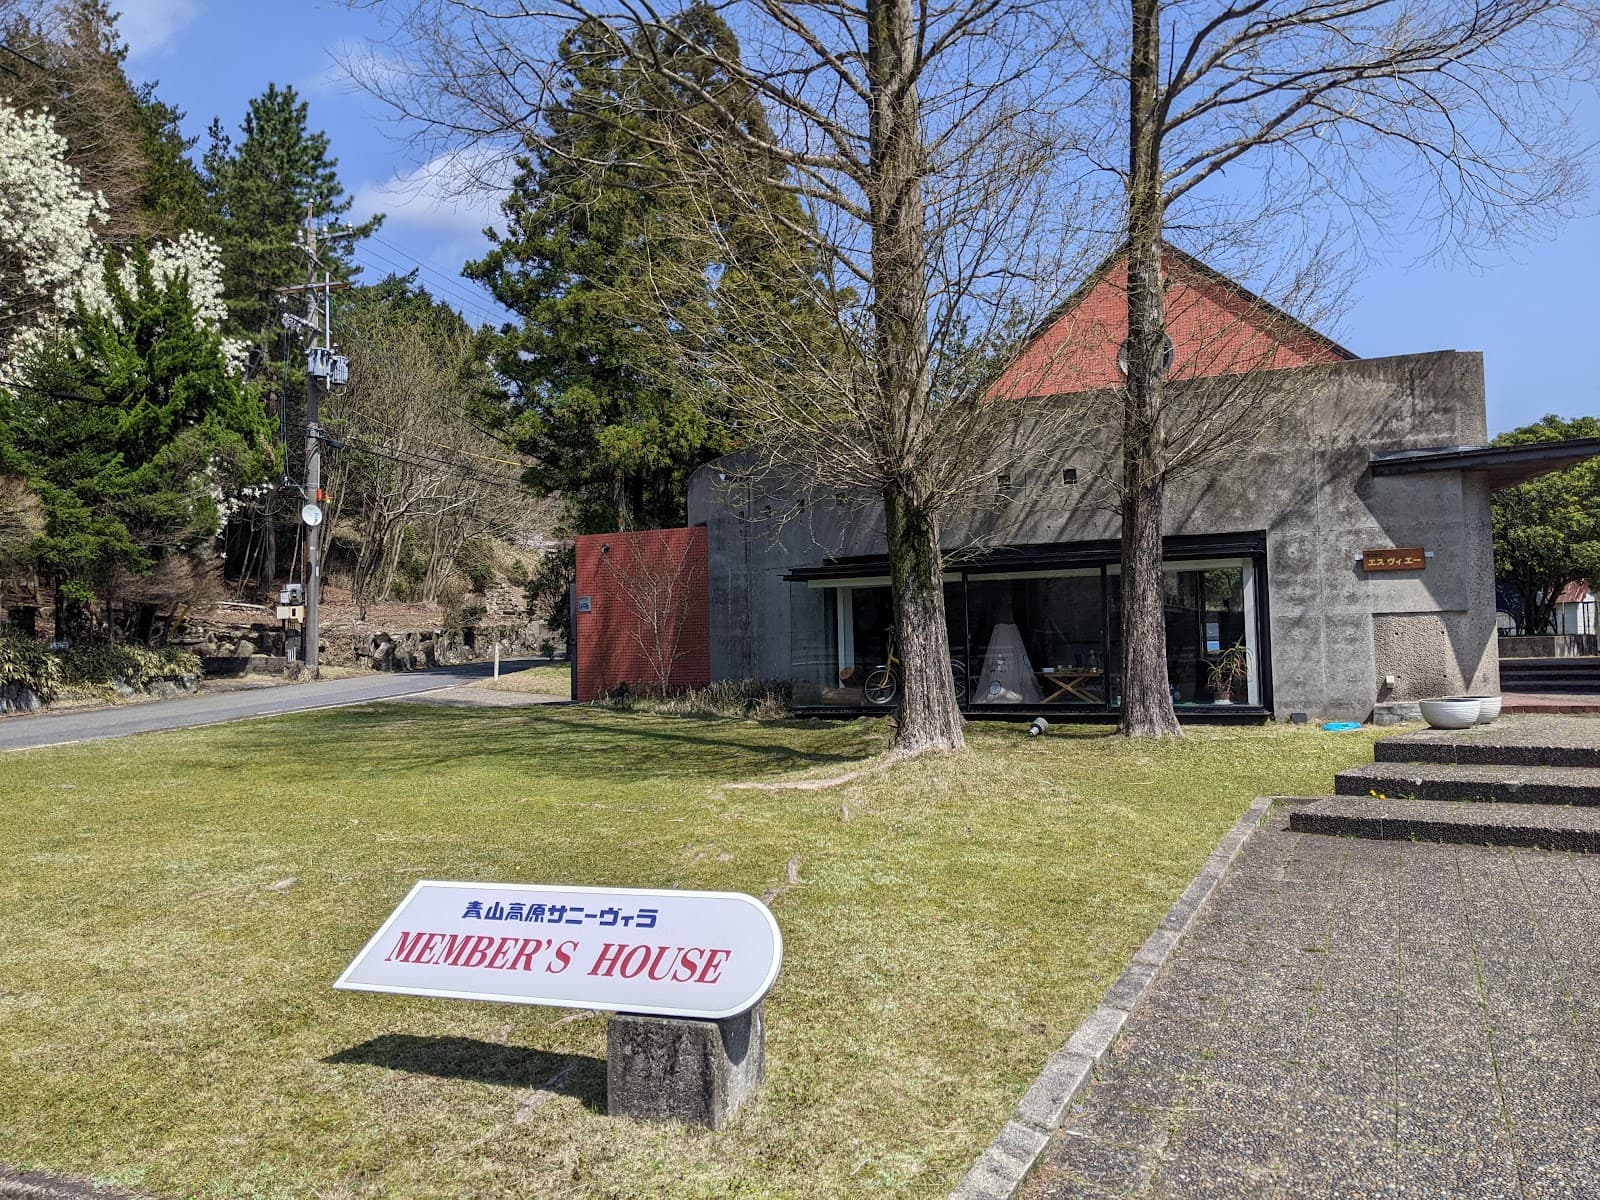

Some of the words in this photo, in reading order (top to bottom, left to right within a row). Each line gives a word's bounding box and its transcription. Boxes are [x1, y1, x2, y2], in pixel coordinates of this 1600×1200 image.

[462, 901, 658, 928] 青山高原サニーヴィラ
[385, 931, 578, 973] MEMBER'S
[588, 944, 731, 983] HOUSE
